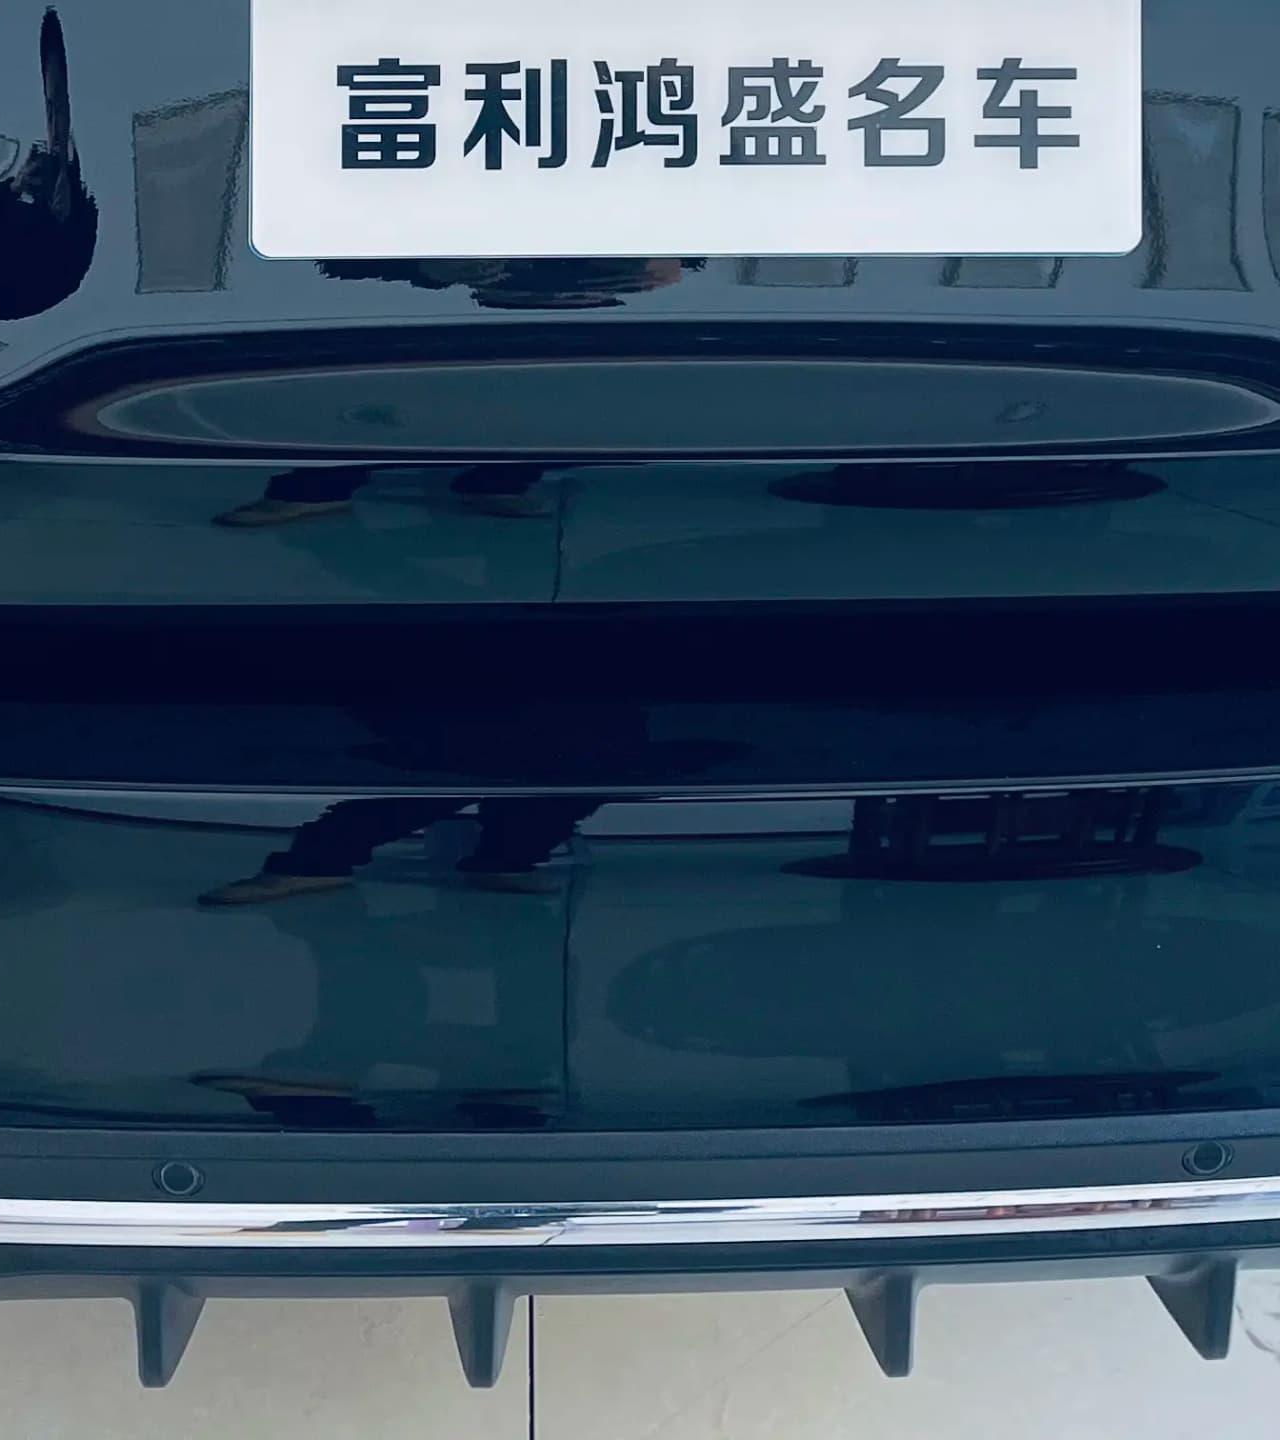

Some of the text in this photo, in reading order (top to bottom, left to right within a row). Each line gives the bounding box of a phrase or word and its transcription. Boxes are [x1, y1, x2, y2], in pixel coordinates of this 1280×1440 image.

[336, 56, 1081, 170] 富利鸿盛名车
